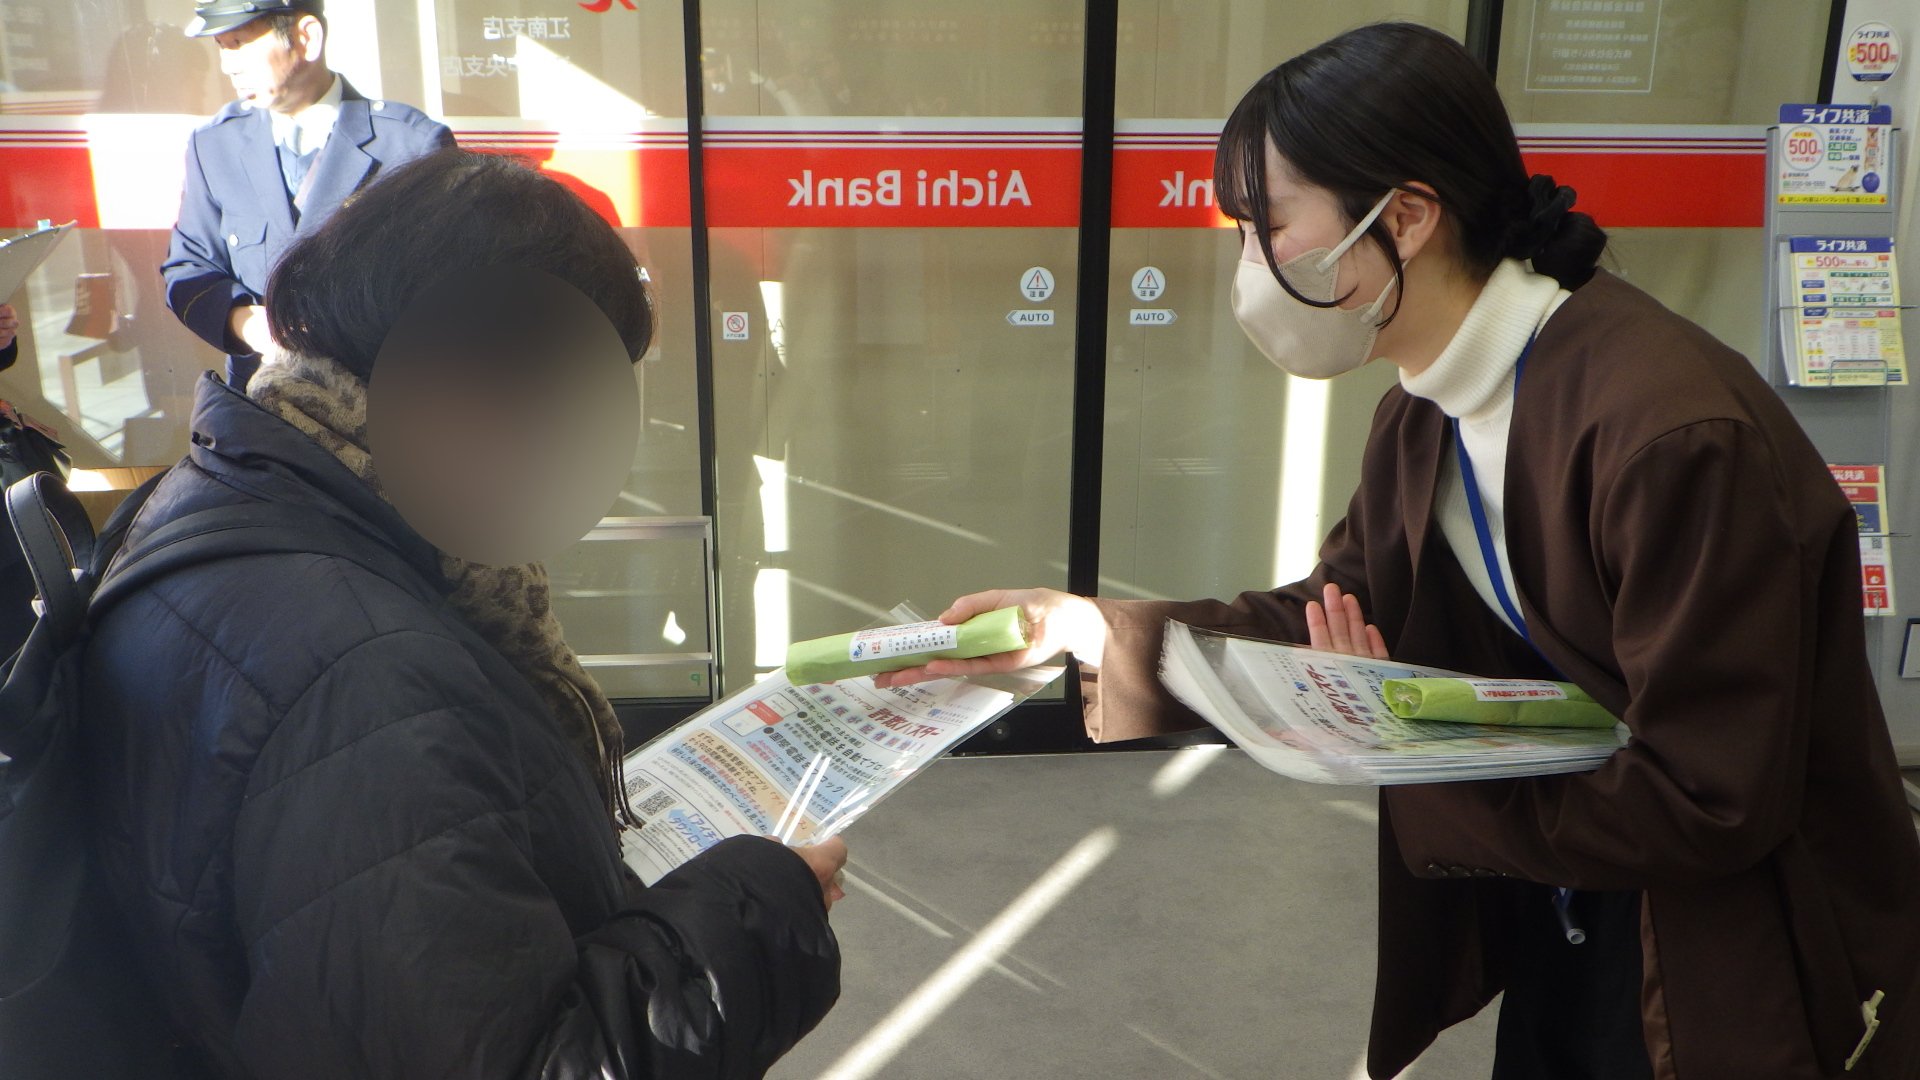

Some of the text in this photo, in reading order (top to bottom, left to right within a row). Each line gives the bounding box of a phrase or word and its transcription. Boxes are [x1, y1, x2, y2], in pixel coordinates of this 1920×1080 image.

[1801, 108, 1871, 125] ライフ共済
[1816, 240, 1868, 251] ライフ共済
[1029, 290, 1045, 298] 注意
[1019, 312, 1050, 322] AUTO
[1135, 311, 1165, 321] AUTO
